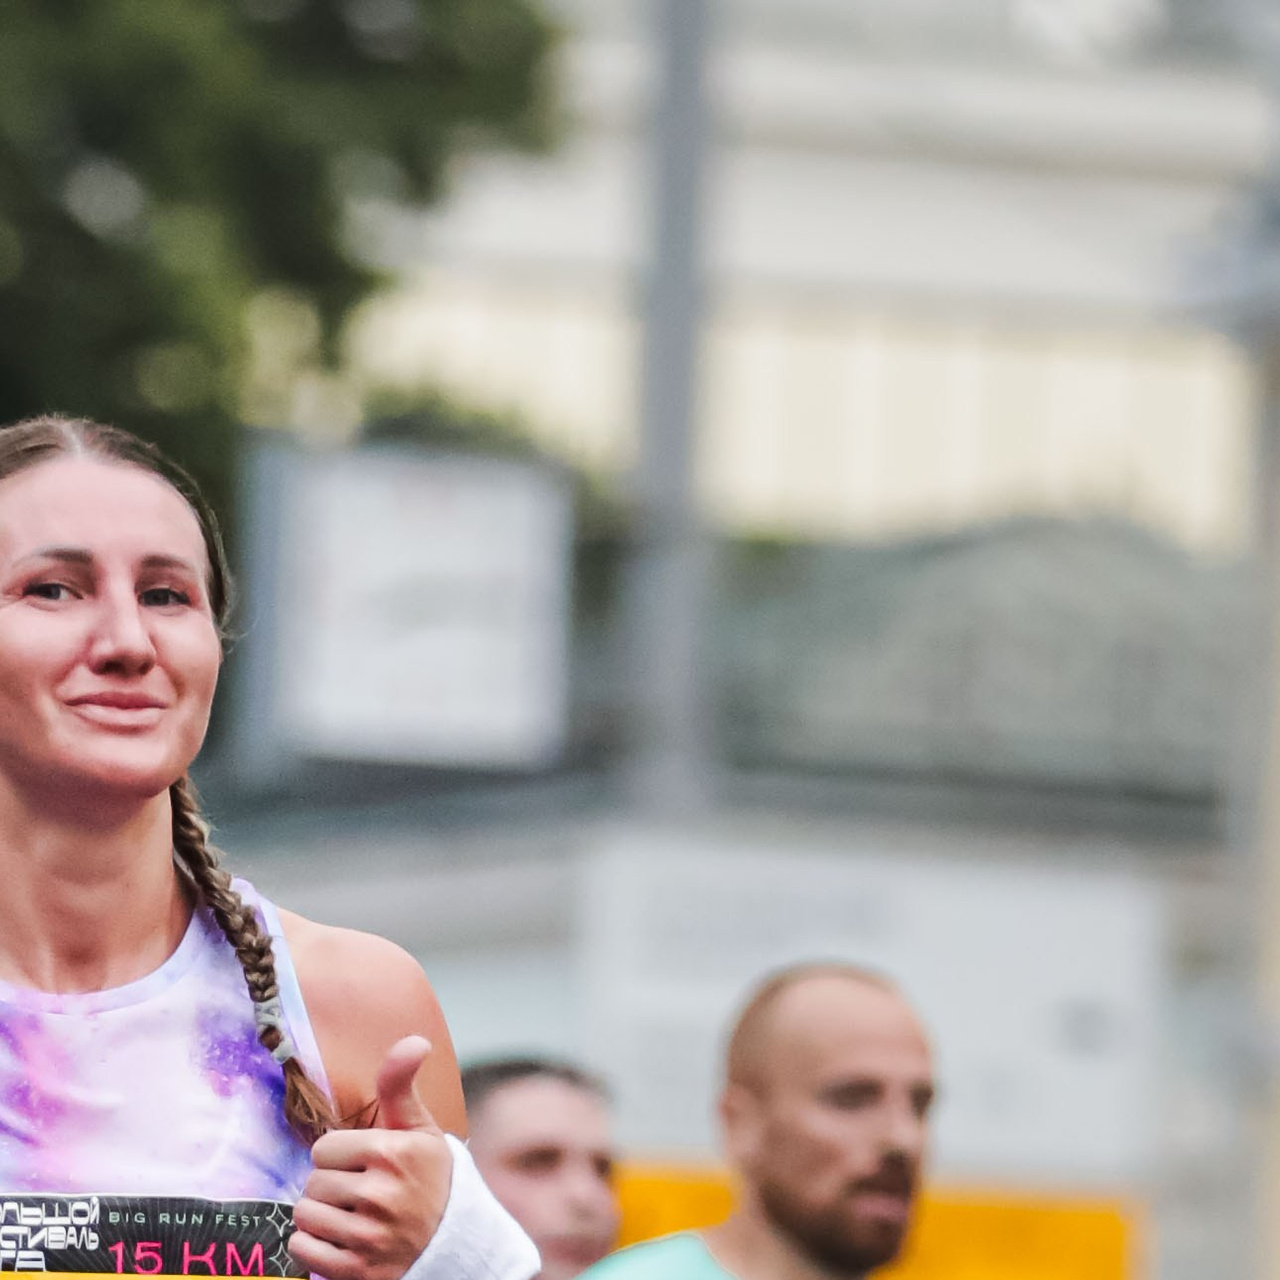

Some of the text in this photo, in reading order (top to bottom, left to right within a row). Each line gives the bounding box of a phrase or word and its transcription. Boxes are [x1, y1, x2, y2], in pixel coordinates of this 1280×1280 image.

[108, 1211, 261, 1227] BIG RUN FEST
[108, 1241, 163, 1276] 15
